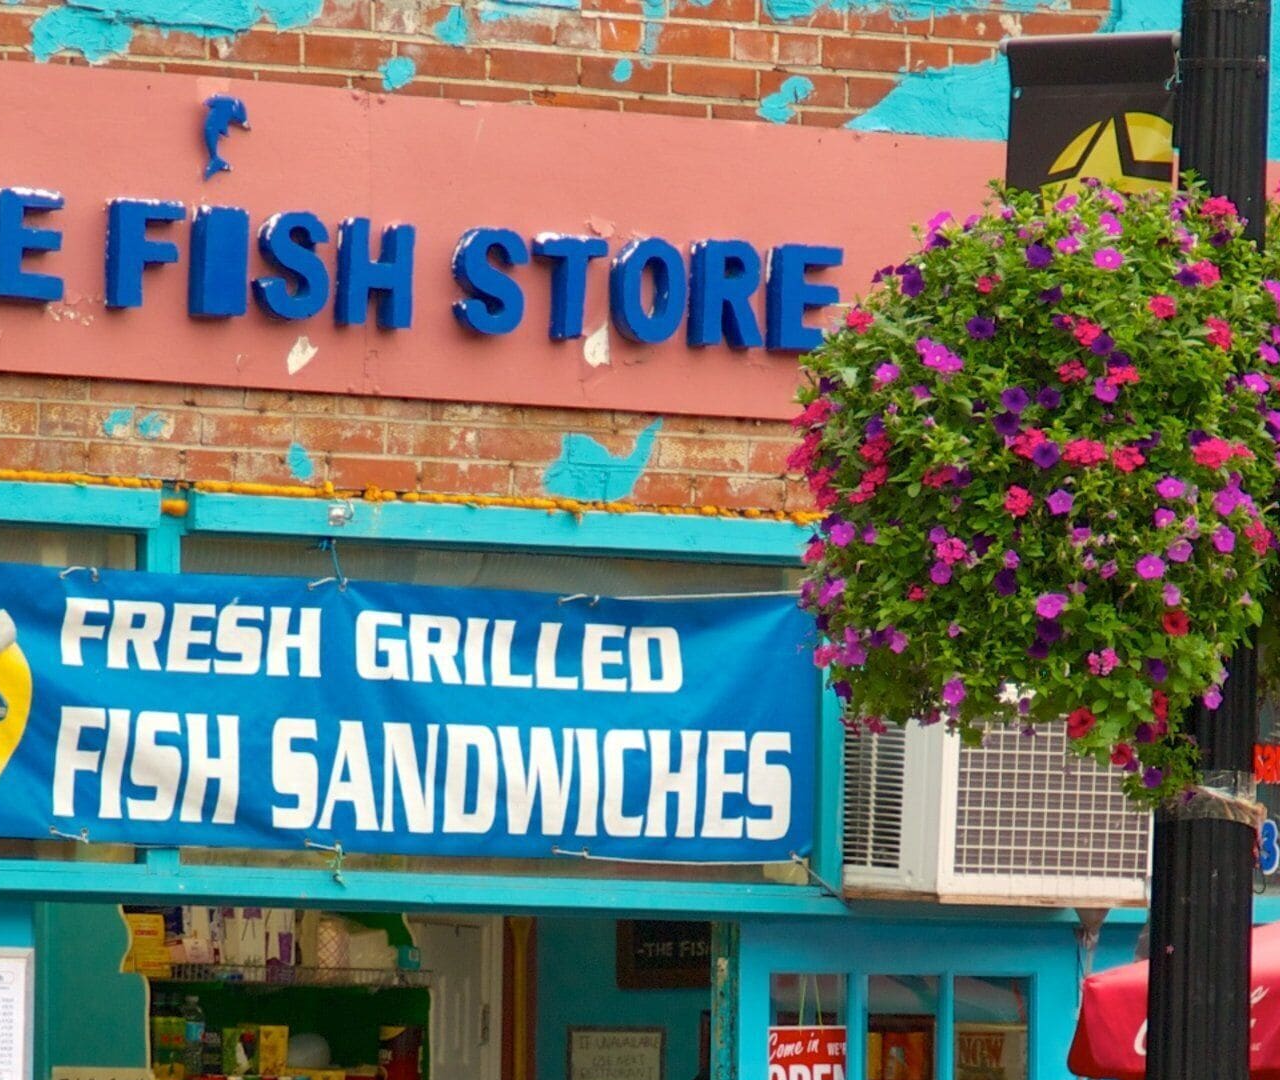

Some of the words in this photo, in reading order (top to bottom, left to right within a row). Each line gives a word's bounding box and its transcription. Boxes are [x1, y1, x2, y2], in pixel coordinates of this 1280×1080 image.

[104, 198, 415, 328] FISH
[452, 227, 844, 352] STORE
[60, 597, 322, 677] FRESH
[356, 610, 683, 694] GRILLED
[52, 706, 240, 824] FISH
[271, 717, 792, 839] SANDWICHES
[769, 1032, 804, 1062] Come
[807, 1032, 820, 1054] in
